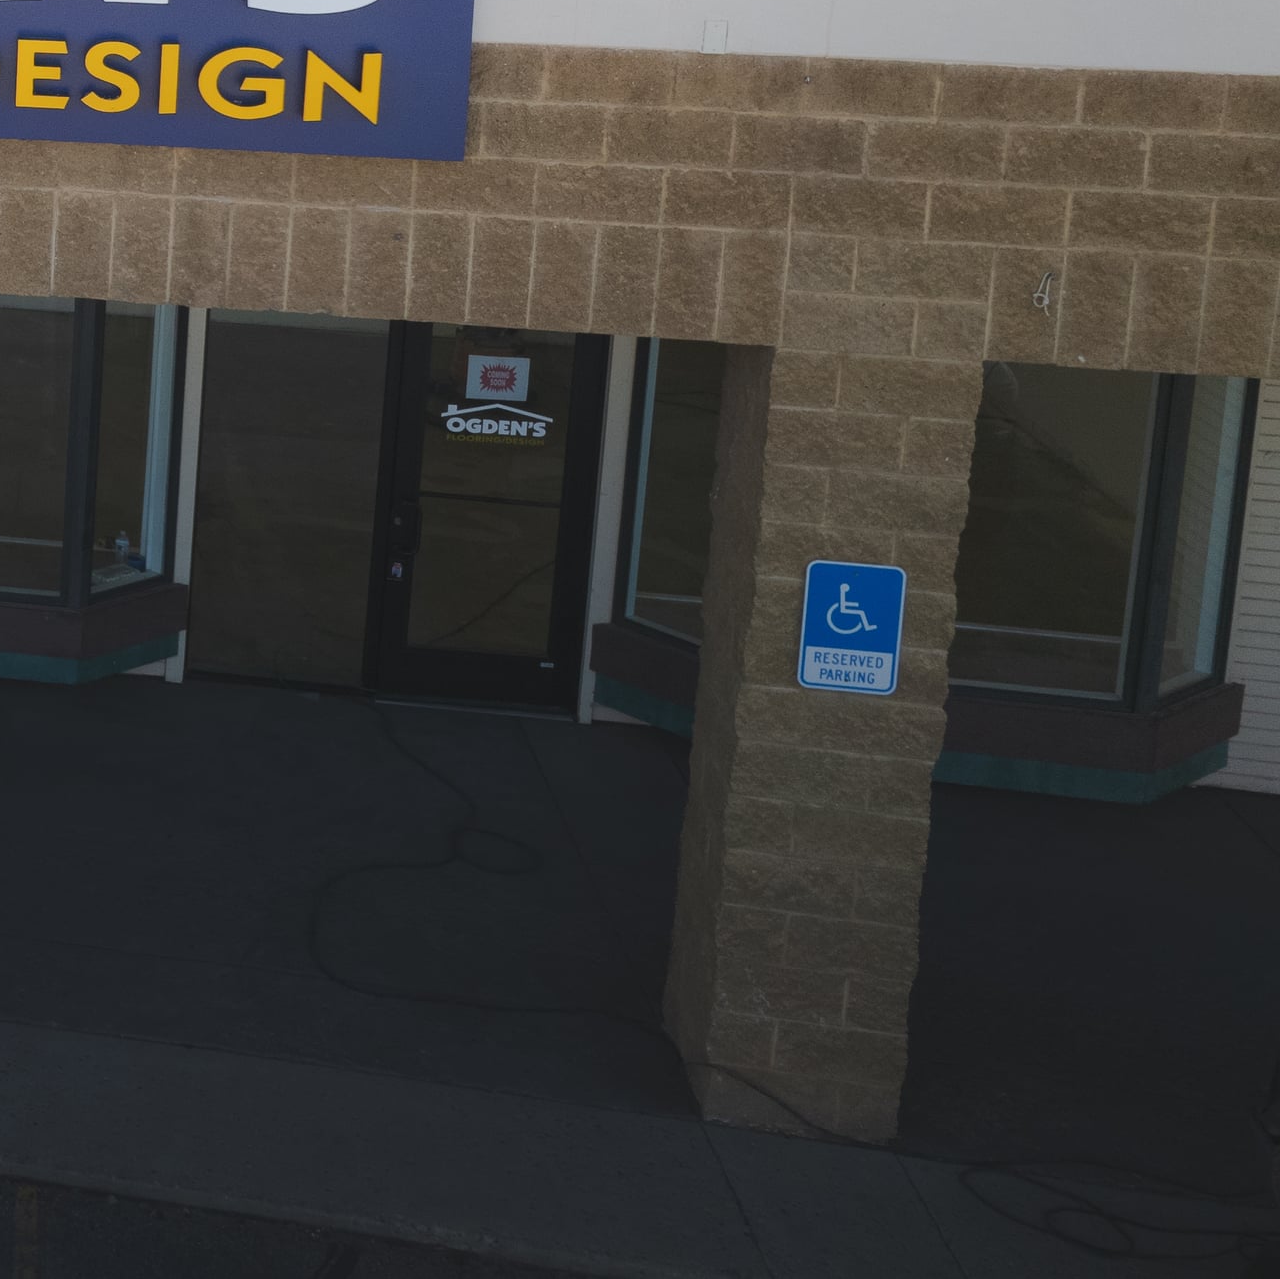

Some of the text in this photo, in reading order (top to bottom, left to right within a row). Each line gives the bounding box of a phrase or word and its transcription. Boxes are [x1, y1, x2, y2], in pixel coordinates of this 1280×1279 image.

[489, 378, 507, 387] SOON
[446, 417, 546, 437] OGDEN'S
[814, 651, 883, 669] RESERVED
[819, 668, 876, 685] PARKING
